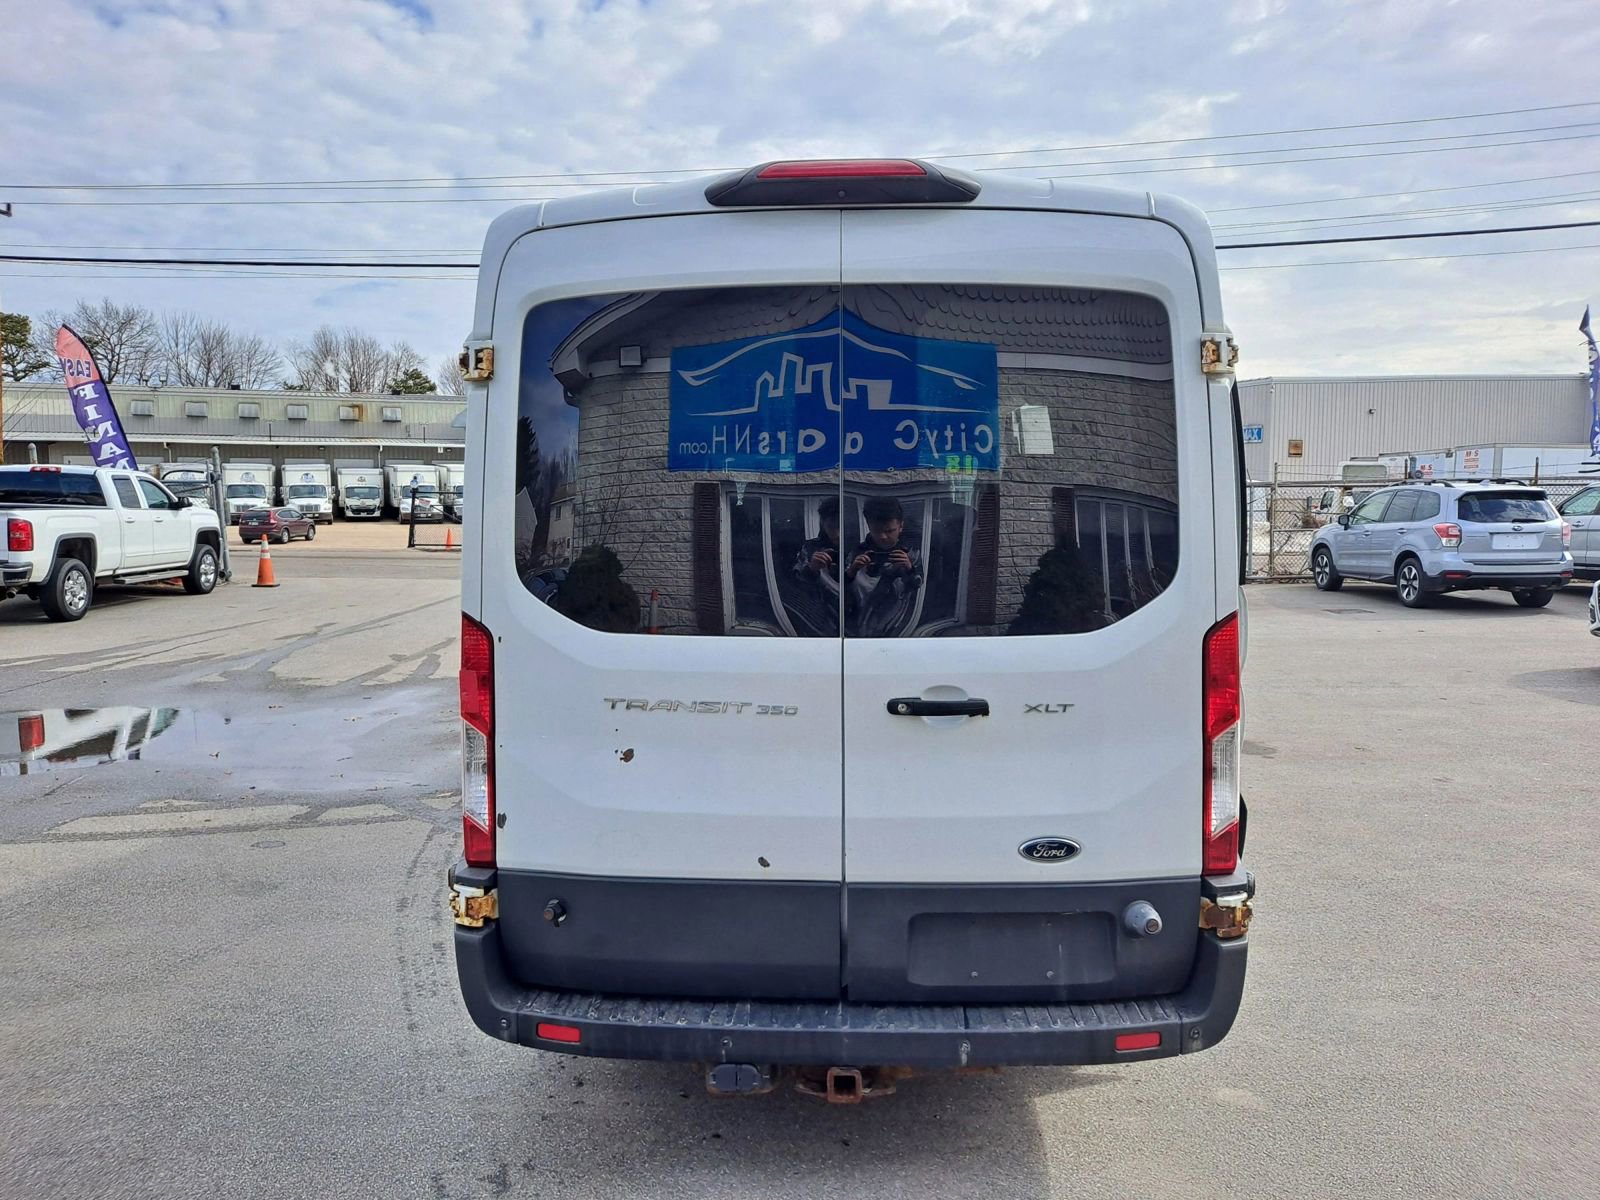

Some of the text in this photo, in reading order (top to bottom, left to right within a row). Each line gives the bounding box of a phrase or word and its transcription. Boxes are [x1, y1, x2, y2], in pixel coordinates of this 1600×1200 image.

[603, 697, 799, 716] TRANSIT 350
[1023, 703, 1075, 714] XLT
[1032, 842, 1068, 857] Ford
